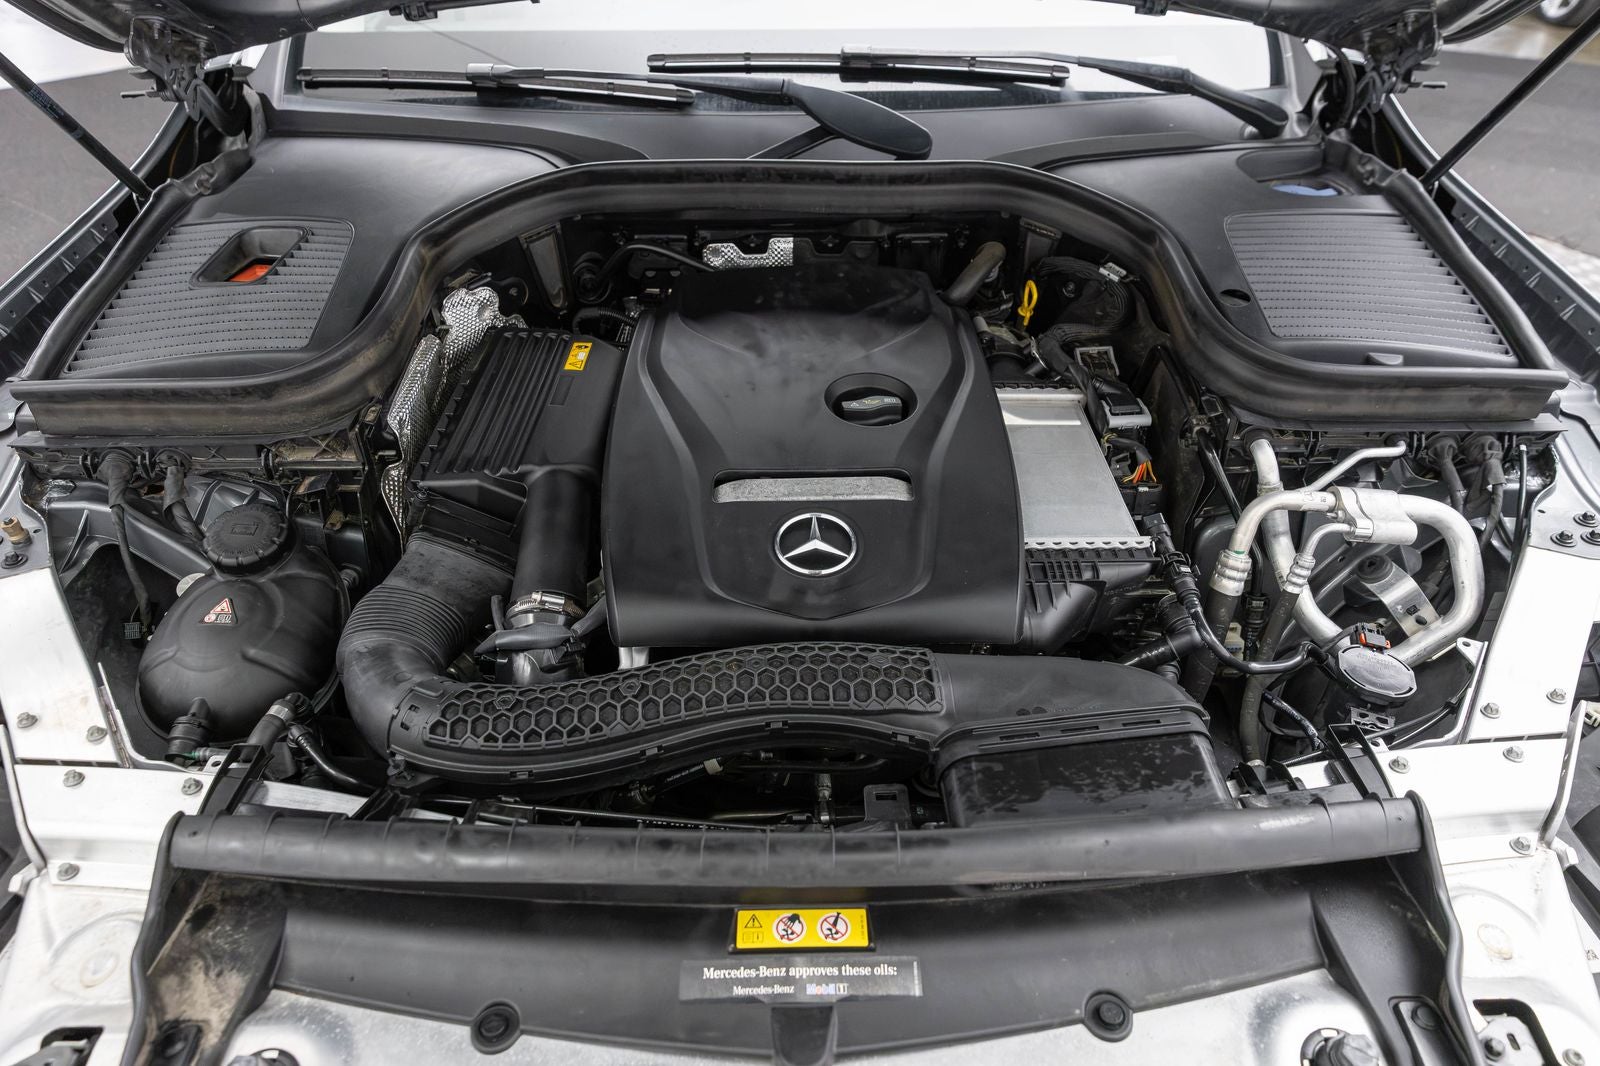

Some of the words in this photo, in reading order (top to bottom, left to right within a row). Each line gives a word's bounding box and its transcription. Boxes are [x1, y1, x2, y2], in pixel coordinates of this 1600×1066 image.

[703, 965, 787, 979] Mercedes-Benz
[789, 967, 839, 979] approves
[841, 964, 872, 976] these
[874, 963, 898, 976] oils:
[732, 984, 795, 996] Mercedes-Benz
